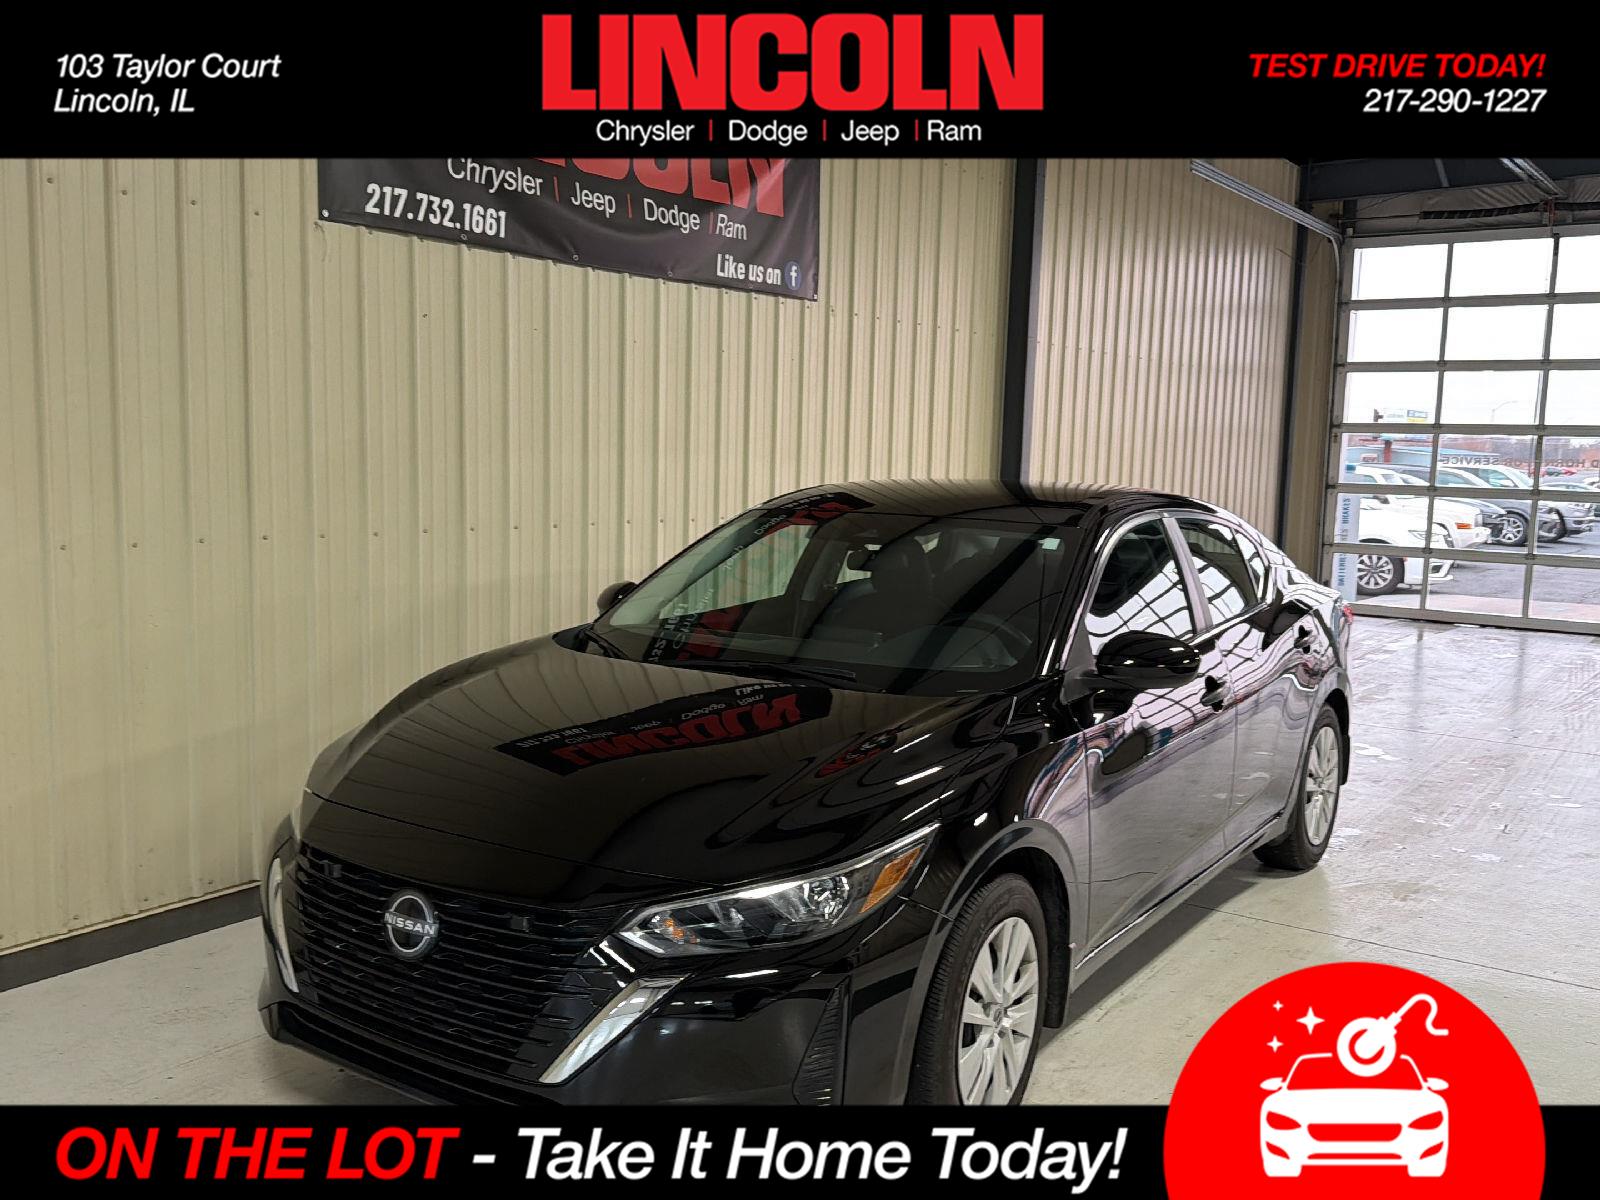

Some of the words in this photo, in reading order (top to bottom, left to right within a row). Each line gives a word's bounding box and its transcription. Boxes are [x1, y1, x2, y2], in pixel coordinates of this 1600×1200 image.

[364, 183, 507, 238] 217.732.1661
[447, 158, 543, 196] Chrysler
[571, 182, 616, 218] Jeep
[643, 198, 700, 234] Dodge
[717, 213, 747, 240] Ram
[717, 253, 745, 280] Like
[749, 264, 763, 284] us
[766, 267, 781, 285] on
[384, 912, 436, 935] NISSAN
